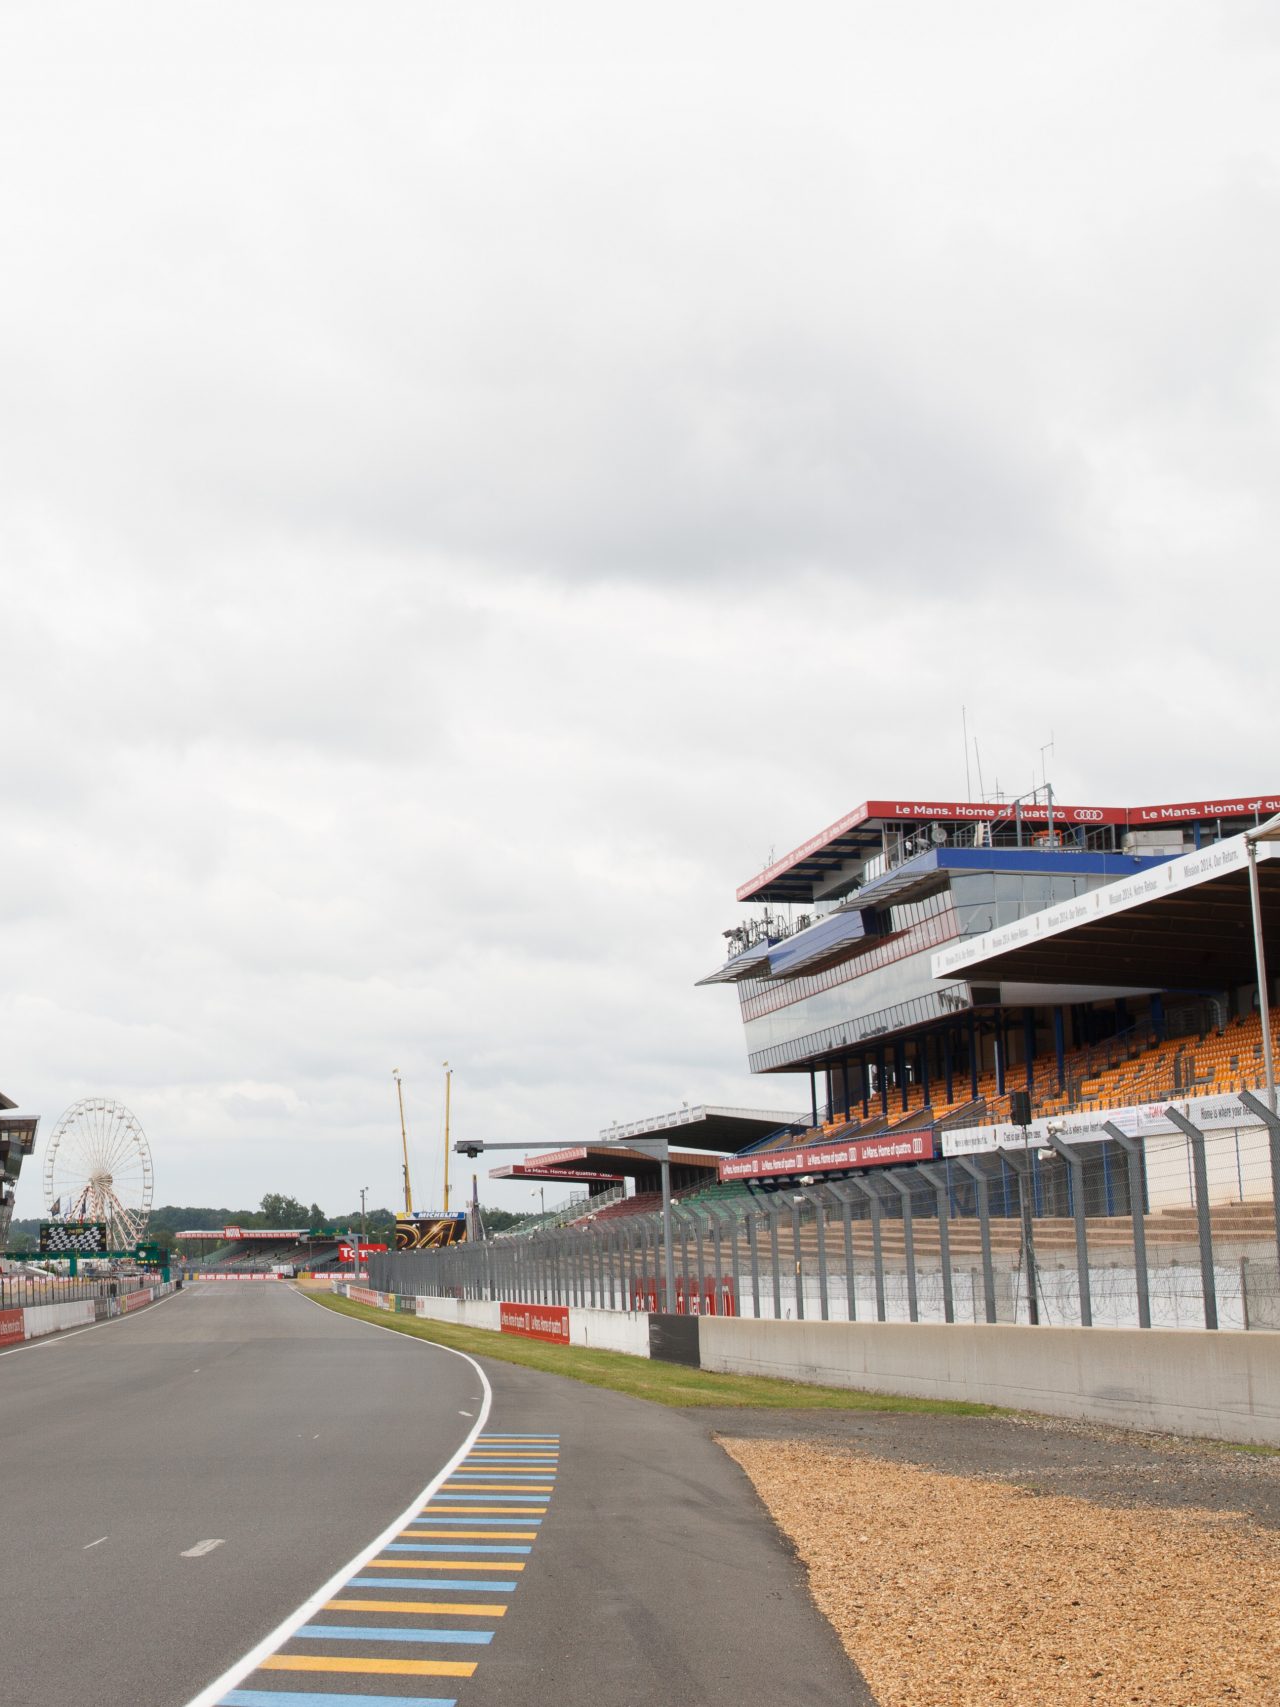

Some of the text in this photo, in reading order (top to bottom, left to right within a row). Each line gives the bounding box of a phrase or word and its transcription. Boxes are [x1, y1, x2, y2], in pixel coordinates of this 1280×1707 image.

[895, 805, 910, 814] Le
[914, 805, 952, 815] Mans.
[955, 806, 995, 817] Home
[998, 807, 1013, 817] of
[1142, 810, 1157, 819] Le
[1161, 807, 1200, 818] Mans.
[1204, 804, 1244, 814] Home
[1248, 800, 1262, 810] of
